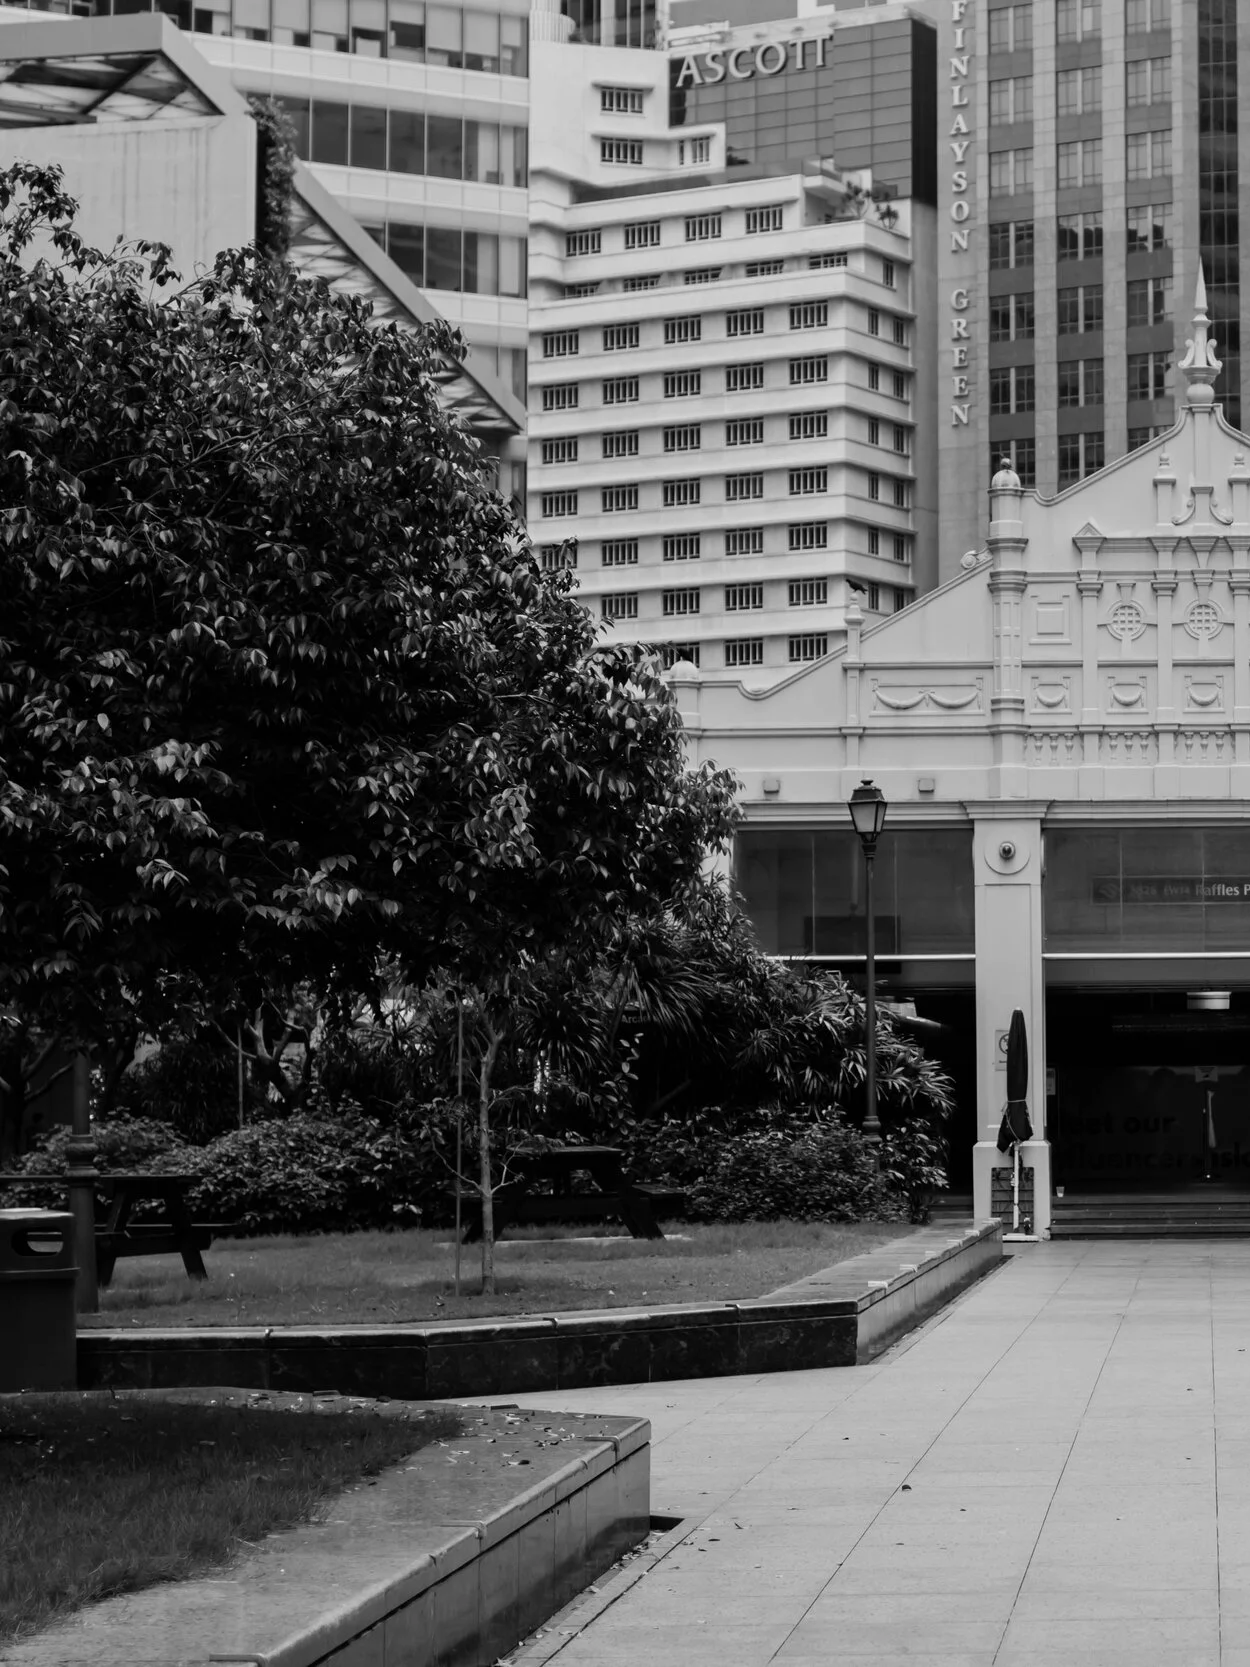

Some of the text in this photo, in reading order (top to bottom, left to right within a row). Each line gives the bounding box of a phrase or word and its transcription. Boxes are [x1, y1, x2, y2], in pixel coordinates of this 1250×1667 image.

[676, 34, 834, 88] ASCOTT
[949, 0, 972, 427] FINLAYSON GREEN
[1195, 883, 1240, 896] Raffles
